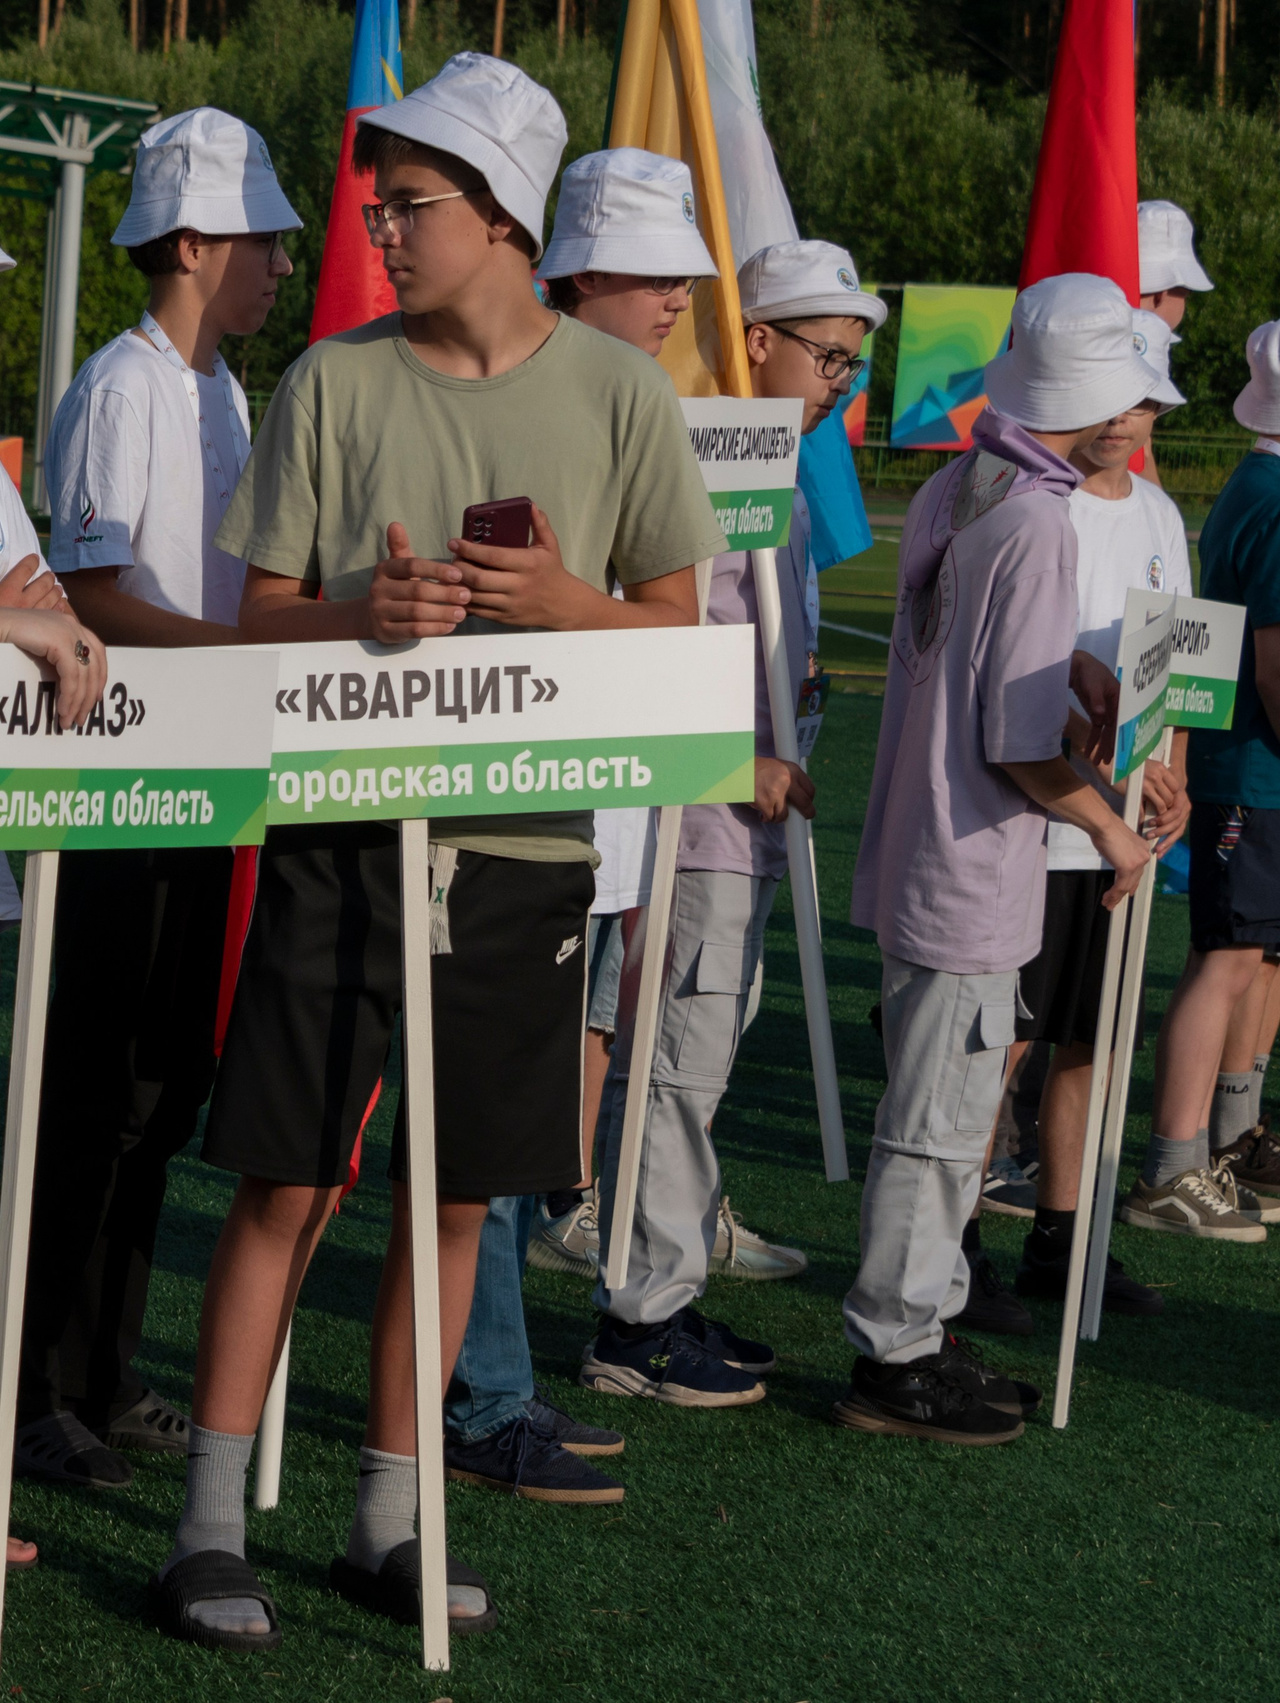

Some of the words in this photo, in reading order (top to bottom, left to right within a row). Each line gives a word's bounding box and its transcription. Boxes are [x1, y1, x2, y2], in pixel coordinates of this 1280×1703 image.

[740, 426, 796, 465] САМОЦВЕТЫ»
[738, 497, 774, 534] область
[275, 664, 560, 724] «КВАРЦИТ»
[1185, 681, 1214, 713] область
[486, 748, 652, 797] область
[111, 778, 215, 827] область
